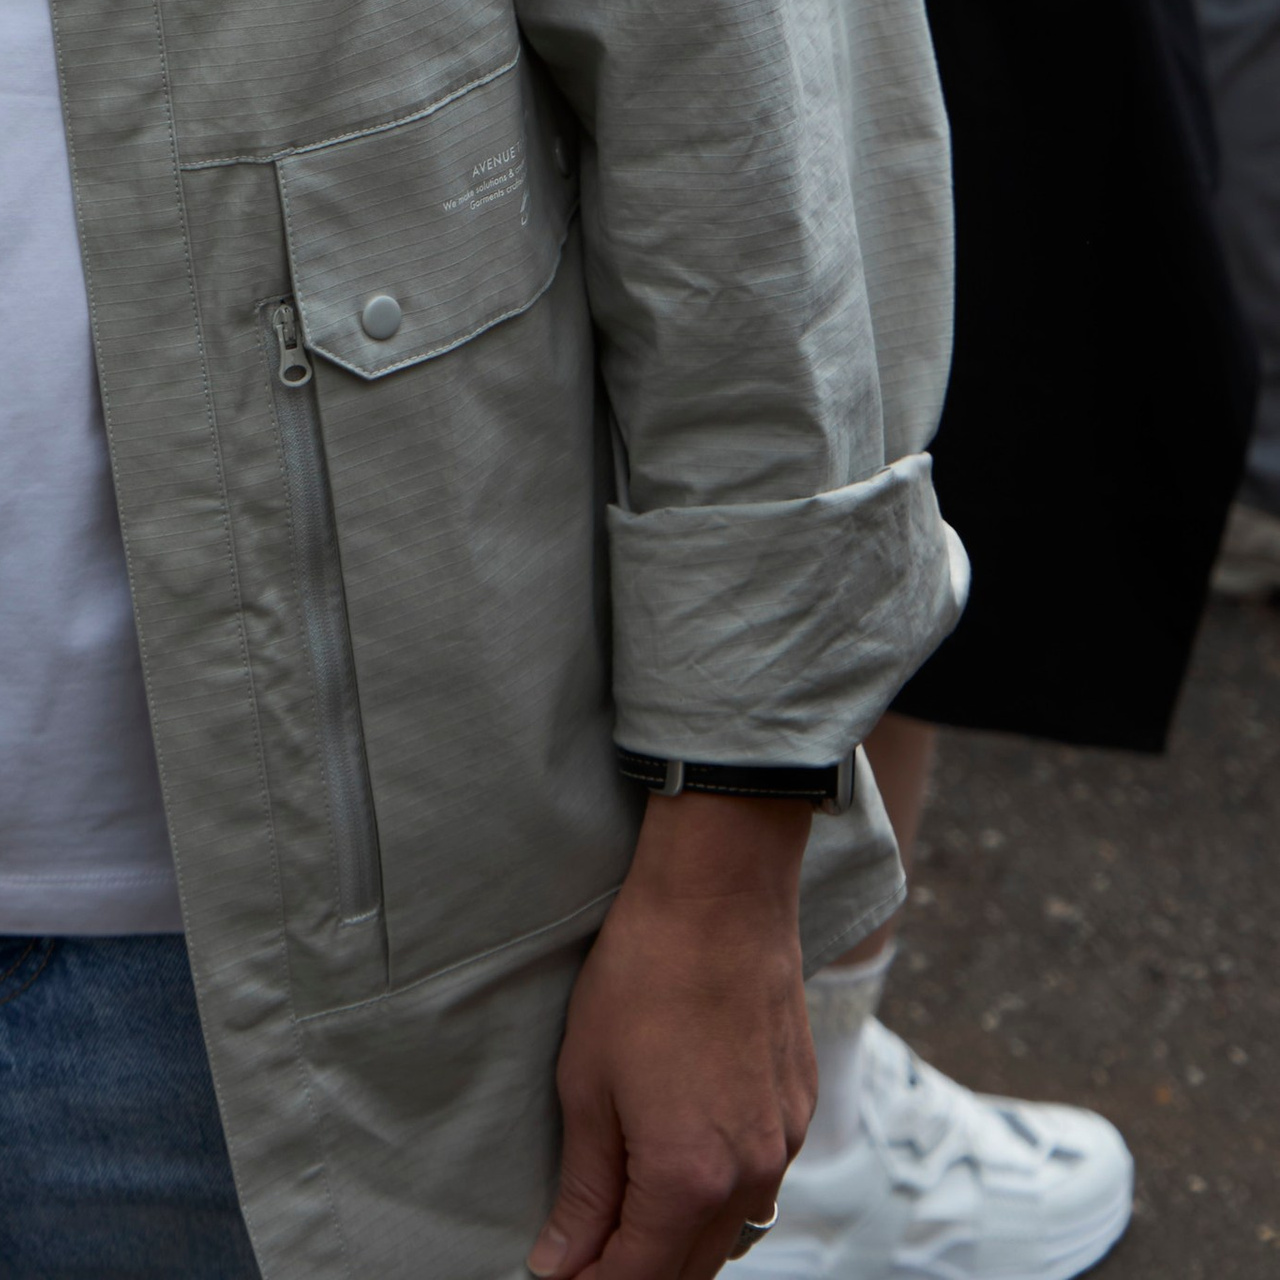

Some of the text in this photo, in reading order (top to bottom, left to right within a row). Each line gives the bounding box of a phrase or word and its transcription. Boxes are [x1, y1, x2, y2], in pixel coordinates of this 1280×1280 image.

[472, 146, 516, 178] AVENUE
[442, 168, 515, 211] We make solutions &
[469, 189, 505, 210] Garments
